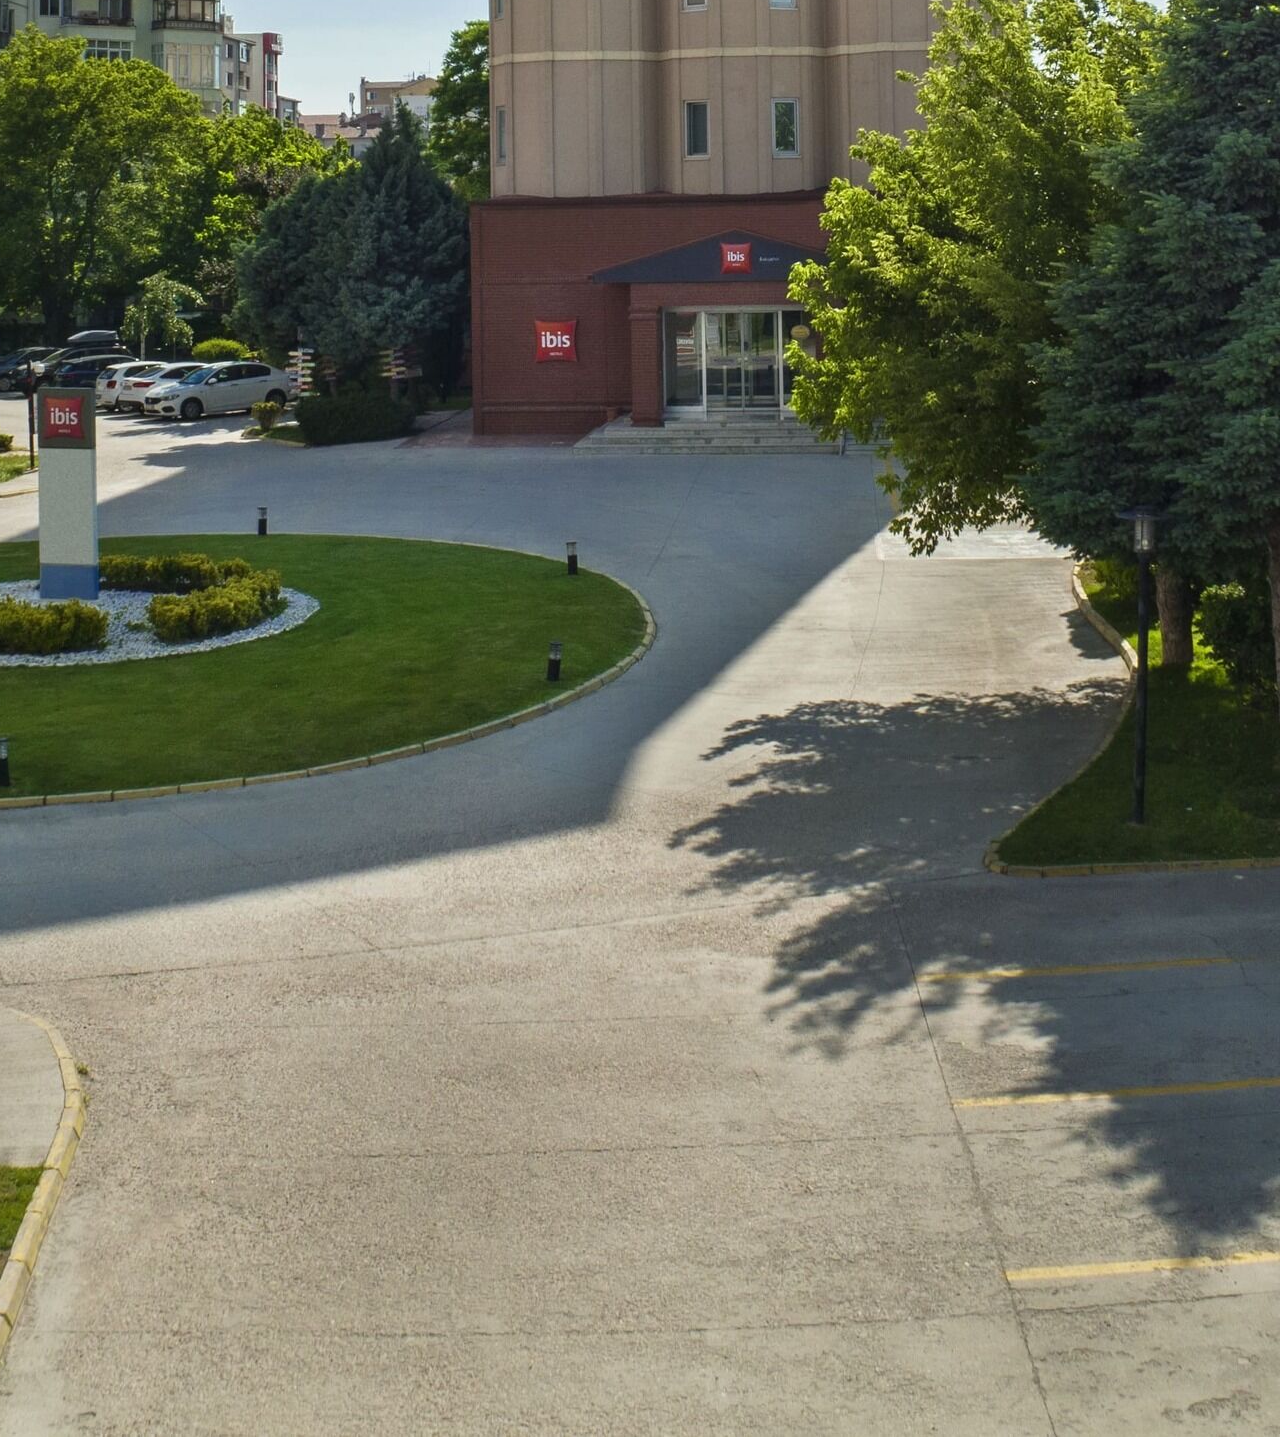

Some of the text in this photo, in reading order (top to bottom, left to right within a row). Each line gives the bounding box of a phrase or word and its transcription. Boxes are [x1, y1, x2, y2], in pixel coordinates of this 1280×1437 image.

[727, 251, 745, 262] ibis
[541, 331, 571, 348] ibis
[50, 407, 78, 425] ibis
